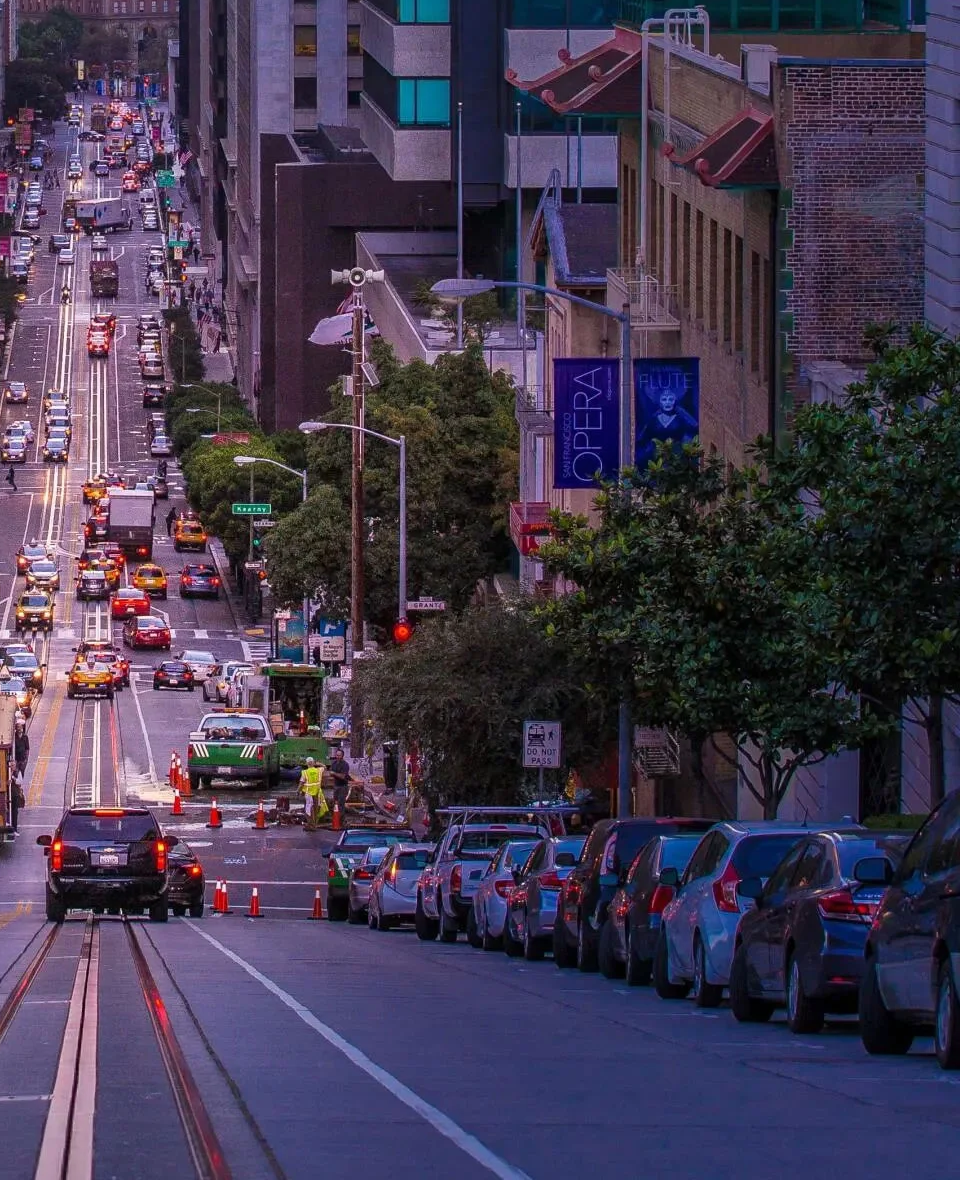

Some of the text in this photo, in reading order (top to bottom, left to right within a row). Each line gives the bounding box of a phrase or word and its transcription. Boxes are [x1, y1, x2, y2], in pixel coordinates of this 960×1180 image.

[639, 372, 693, 389] FLUTE
[573, 366, 602, 482] OPERA
[563, 412, 571, 460] FRANCISCO
[526, 748, 557, 756] DO NOT
[531, 757, 552, 765] PASS
